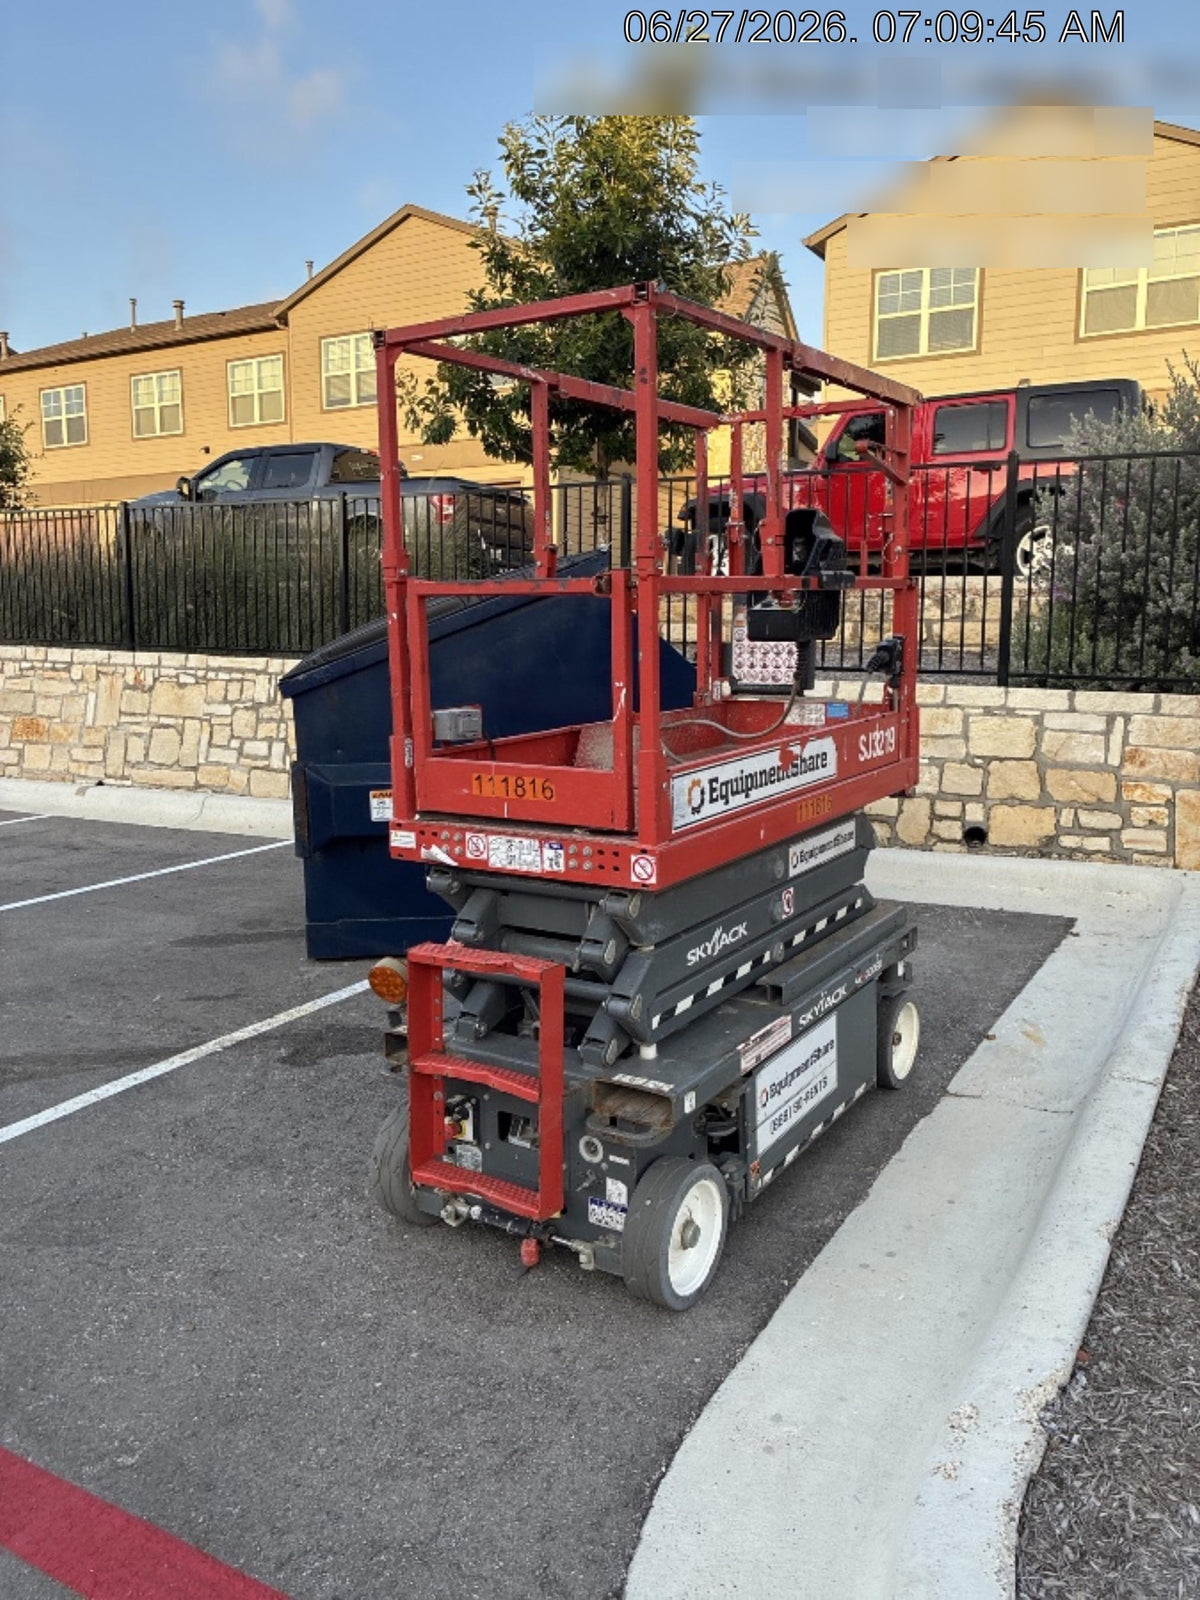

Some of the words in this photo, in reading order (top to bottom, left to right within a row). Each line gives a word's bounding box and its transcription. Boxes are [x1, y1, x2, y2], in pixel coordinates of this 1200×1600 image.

[474, 774, 554, 800] 111816
[707, 750, 828, 806] EquipmenShare
[686, 921, 747, 966] SKYJACK
[799, 983, 847, 1030] SKYJACK
